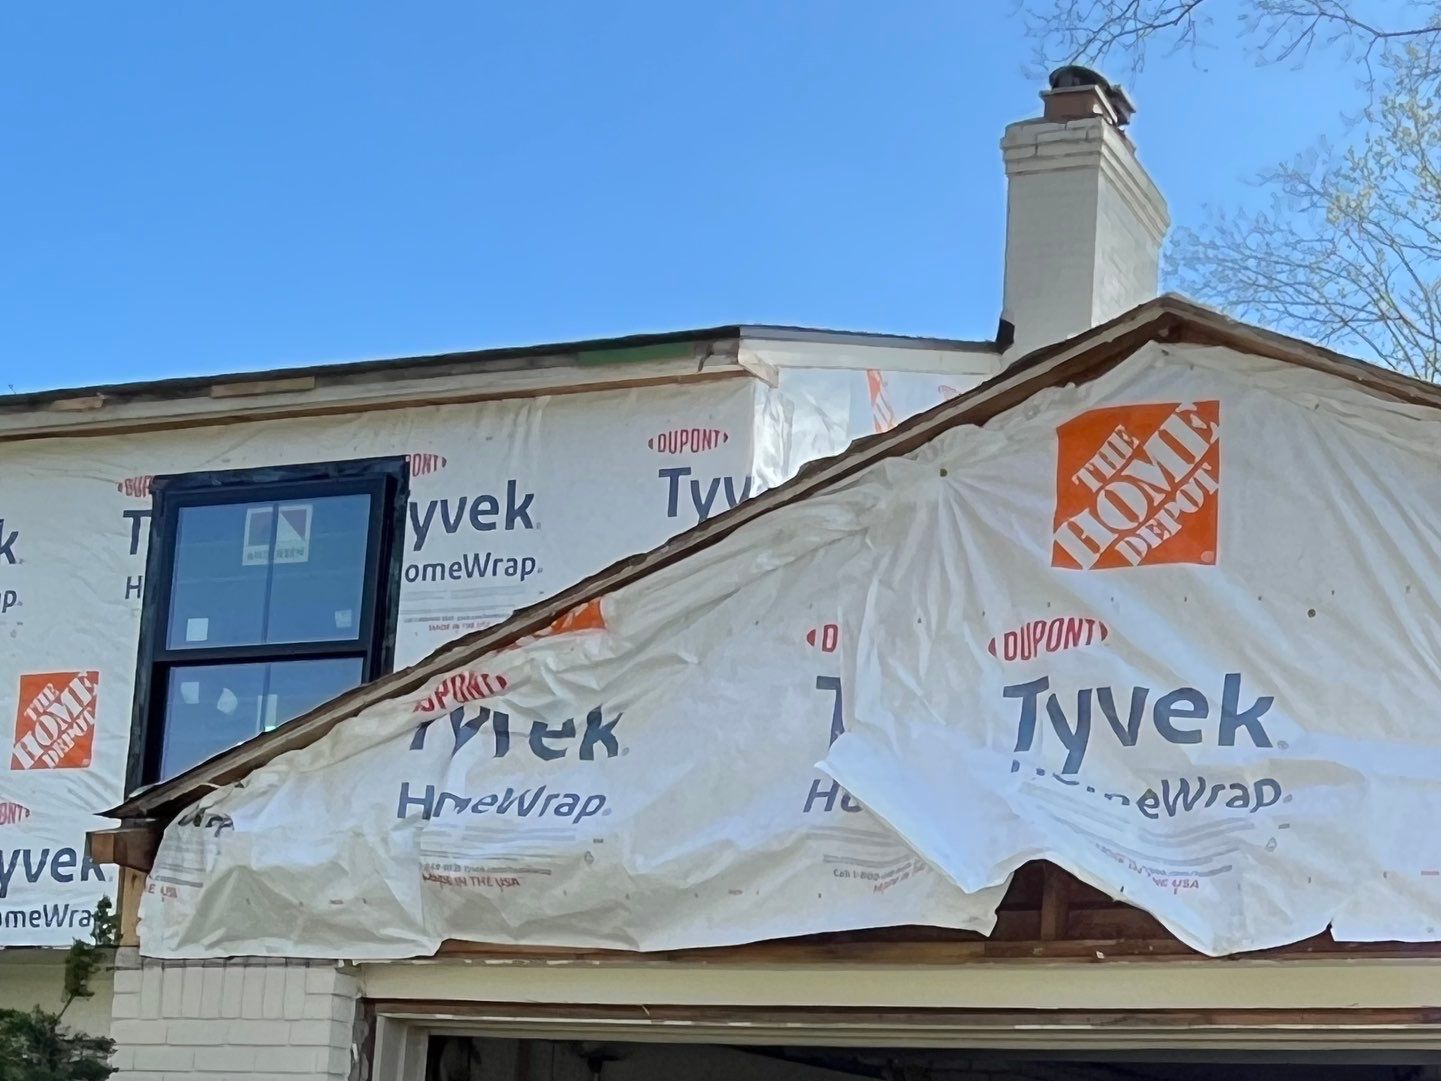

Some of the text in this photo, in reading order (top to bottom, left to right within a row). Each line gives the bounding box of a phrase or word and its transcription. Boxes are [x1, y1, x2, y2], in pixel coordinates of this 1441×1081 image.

[408, 453, 439, 477] ONT
[657, 428, 721, 454] DUPONT
[1072, 424, 1139, 493] THE
[1053, 402, 1220, 571] HOME
[1115, 462, 1219, 567] DEPOT
[1003, 617, 1095, 661] DUPONT
[12, 671, 98, 769] HOME
[23, 682, 60, 721] THE
[1002, 673, 1274, 774] Tyvek
[42, 707, 95, 769] DEPOT
